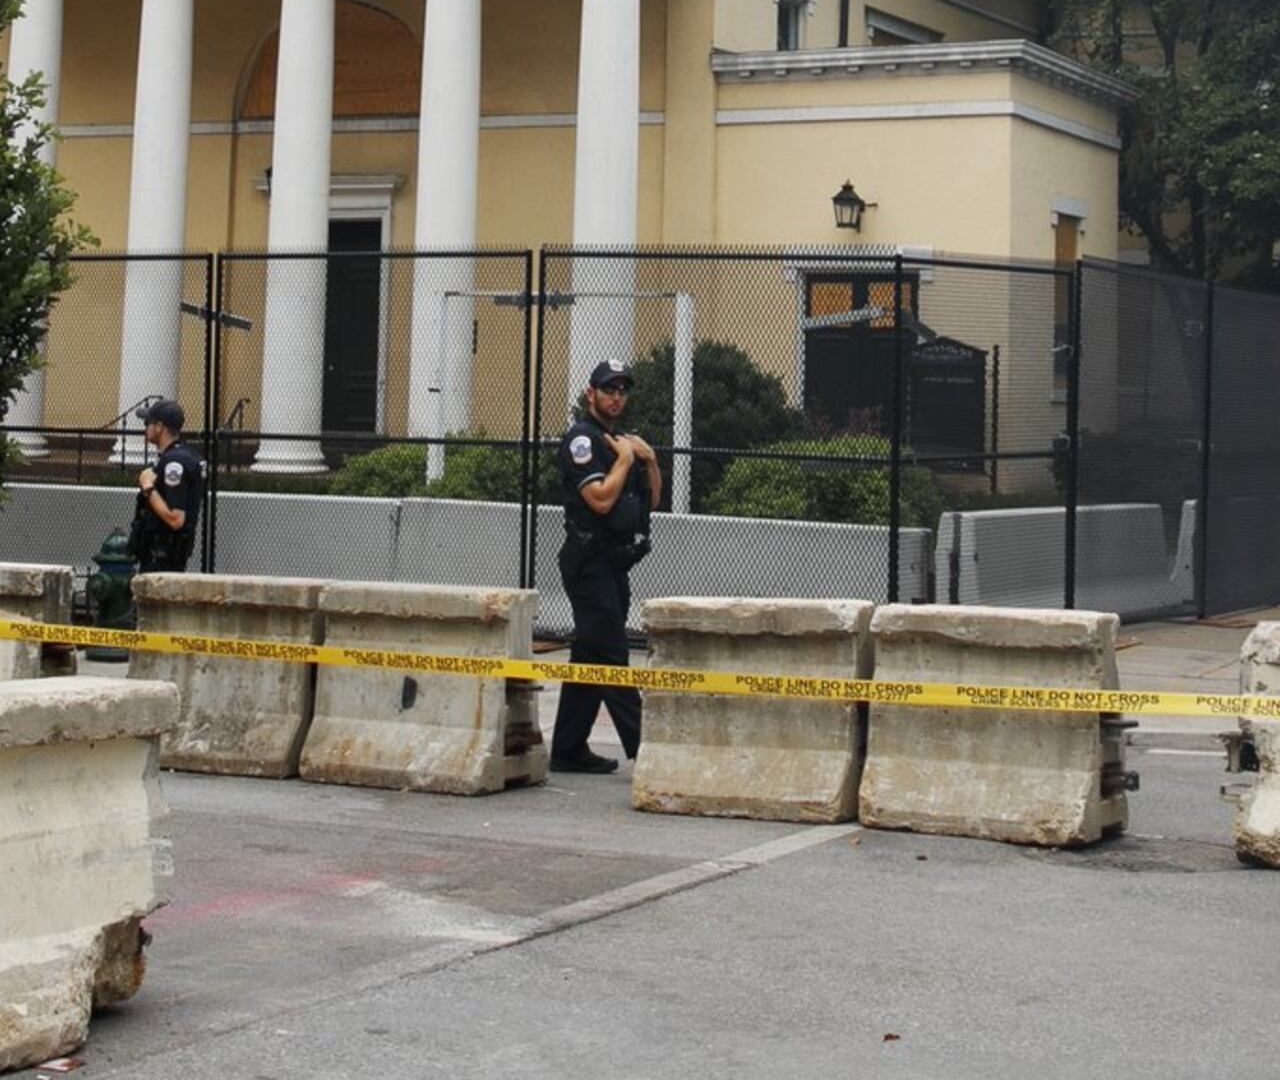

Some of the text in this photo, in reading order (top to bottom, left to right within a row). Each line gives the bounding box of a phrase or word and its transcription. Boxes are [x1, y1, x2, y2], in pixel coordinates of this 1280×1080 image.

[11, 623, 44, 633] POLICE
[90, 630, 110, 639] NOT
[113, 632, 147, 642] CROSS
[171, 636, 208, 647] POLICE
[279, 646, 318, 656] CROSS
[343, 650, 384, 660] POLICE
[387, 653, 412, 662] LINE
[416, 655, 432, 664] DO
[436, 657, 460, 667] NOT
[462, 659, 504, 670] CROSS
[531, 662, 705, 683] POLICE LINE DO NOT CROSS
[735, 675, 923, 695] POLICE LINE DO NOT CROSS
[956, 686, 1160, 705] POLICE LINE DO NOT CROSS
[970, 696, 1005, 705] CRIME
[1009, 698, 1060, 708] SOLVERS
[1196, 696, 1251, 707] POLICE
[1211, 705, 1247, 714] CRIME
